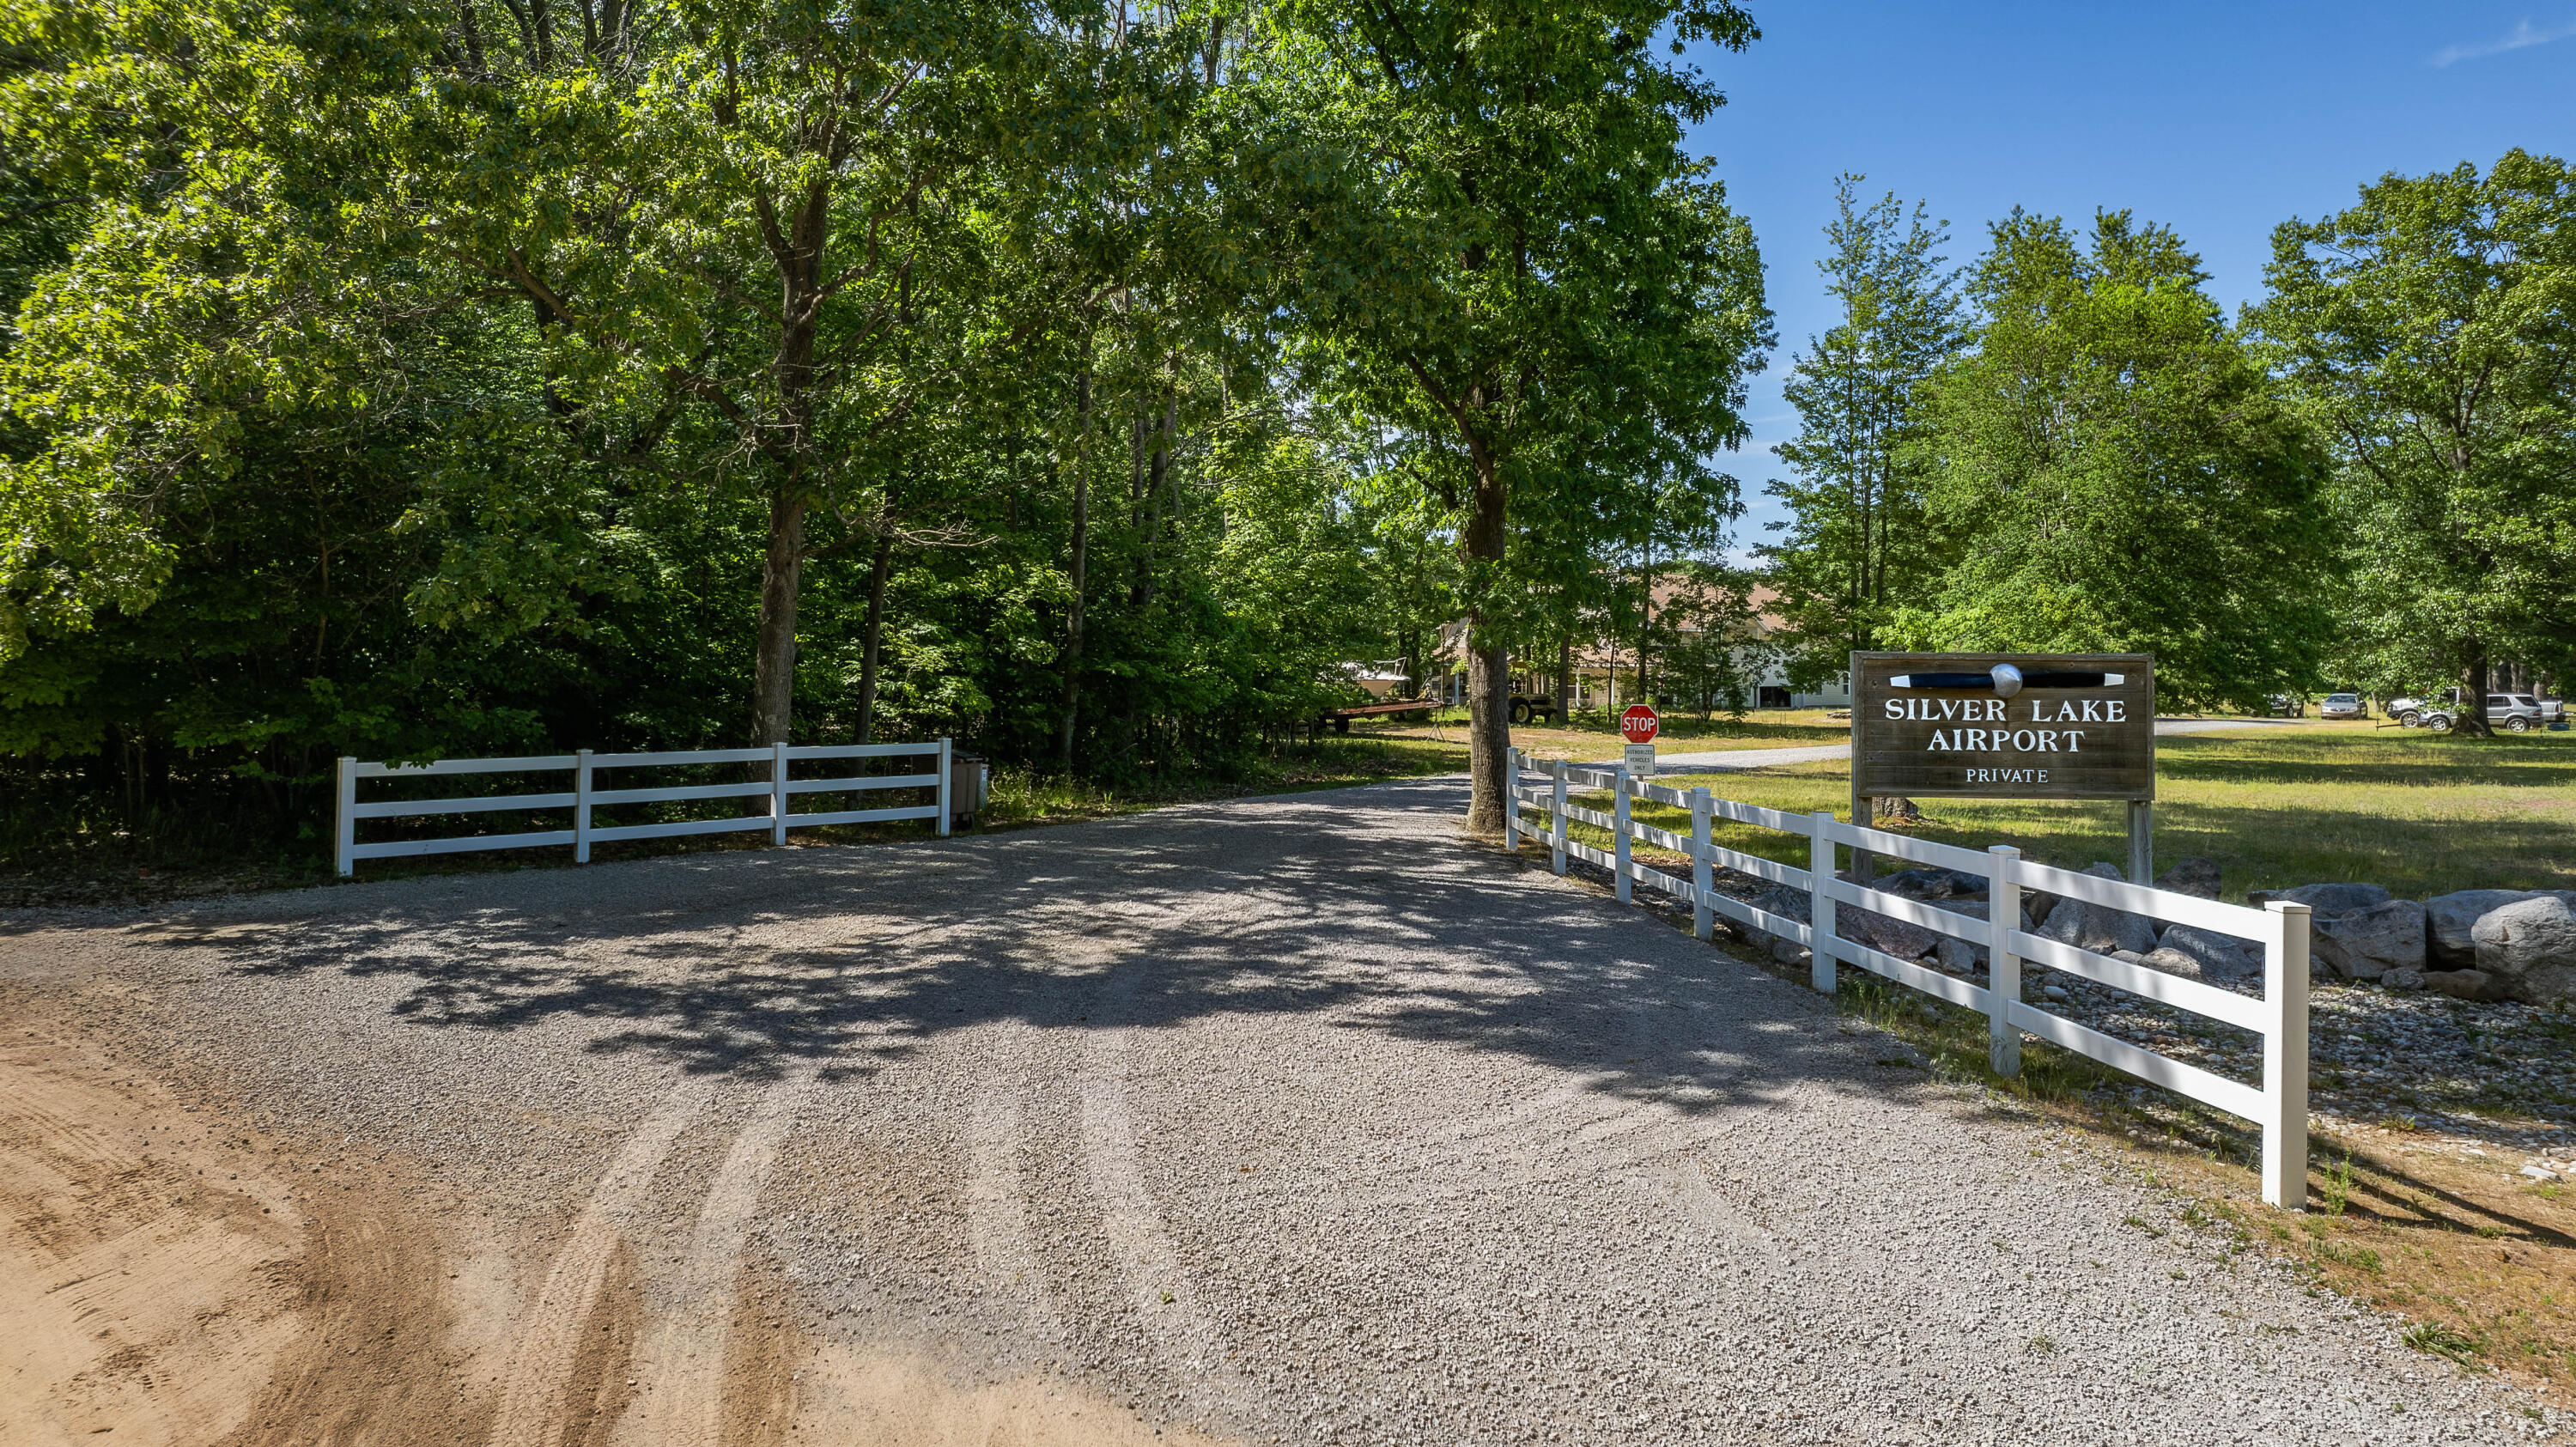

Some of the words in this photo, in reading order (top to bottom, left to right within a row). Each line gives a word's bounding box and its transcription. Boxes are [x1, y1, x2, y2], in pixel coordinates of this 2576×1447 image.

[1885, 698, 2006, 721] SILVER
[2032, 700, 2126, 722] LAKE
[1624, 717, 1656, 732] STOP
[1927, 728, 2085, 752] AIRPORT
[1966, 769, 2049, 783] PRIVATE
